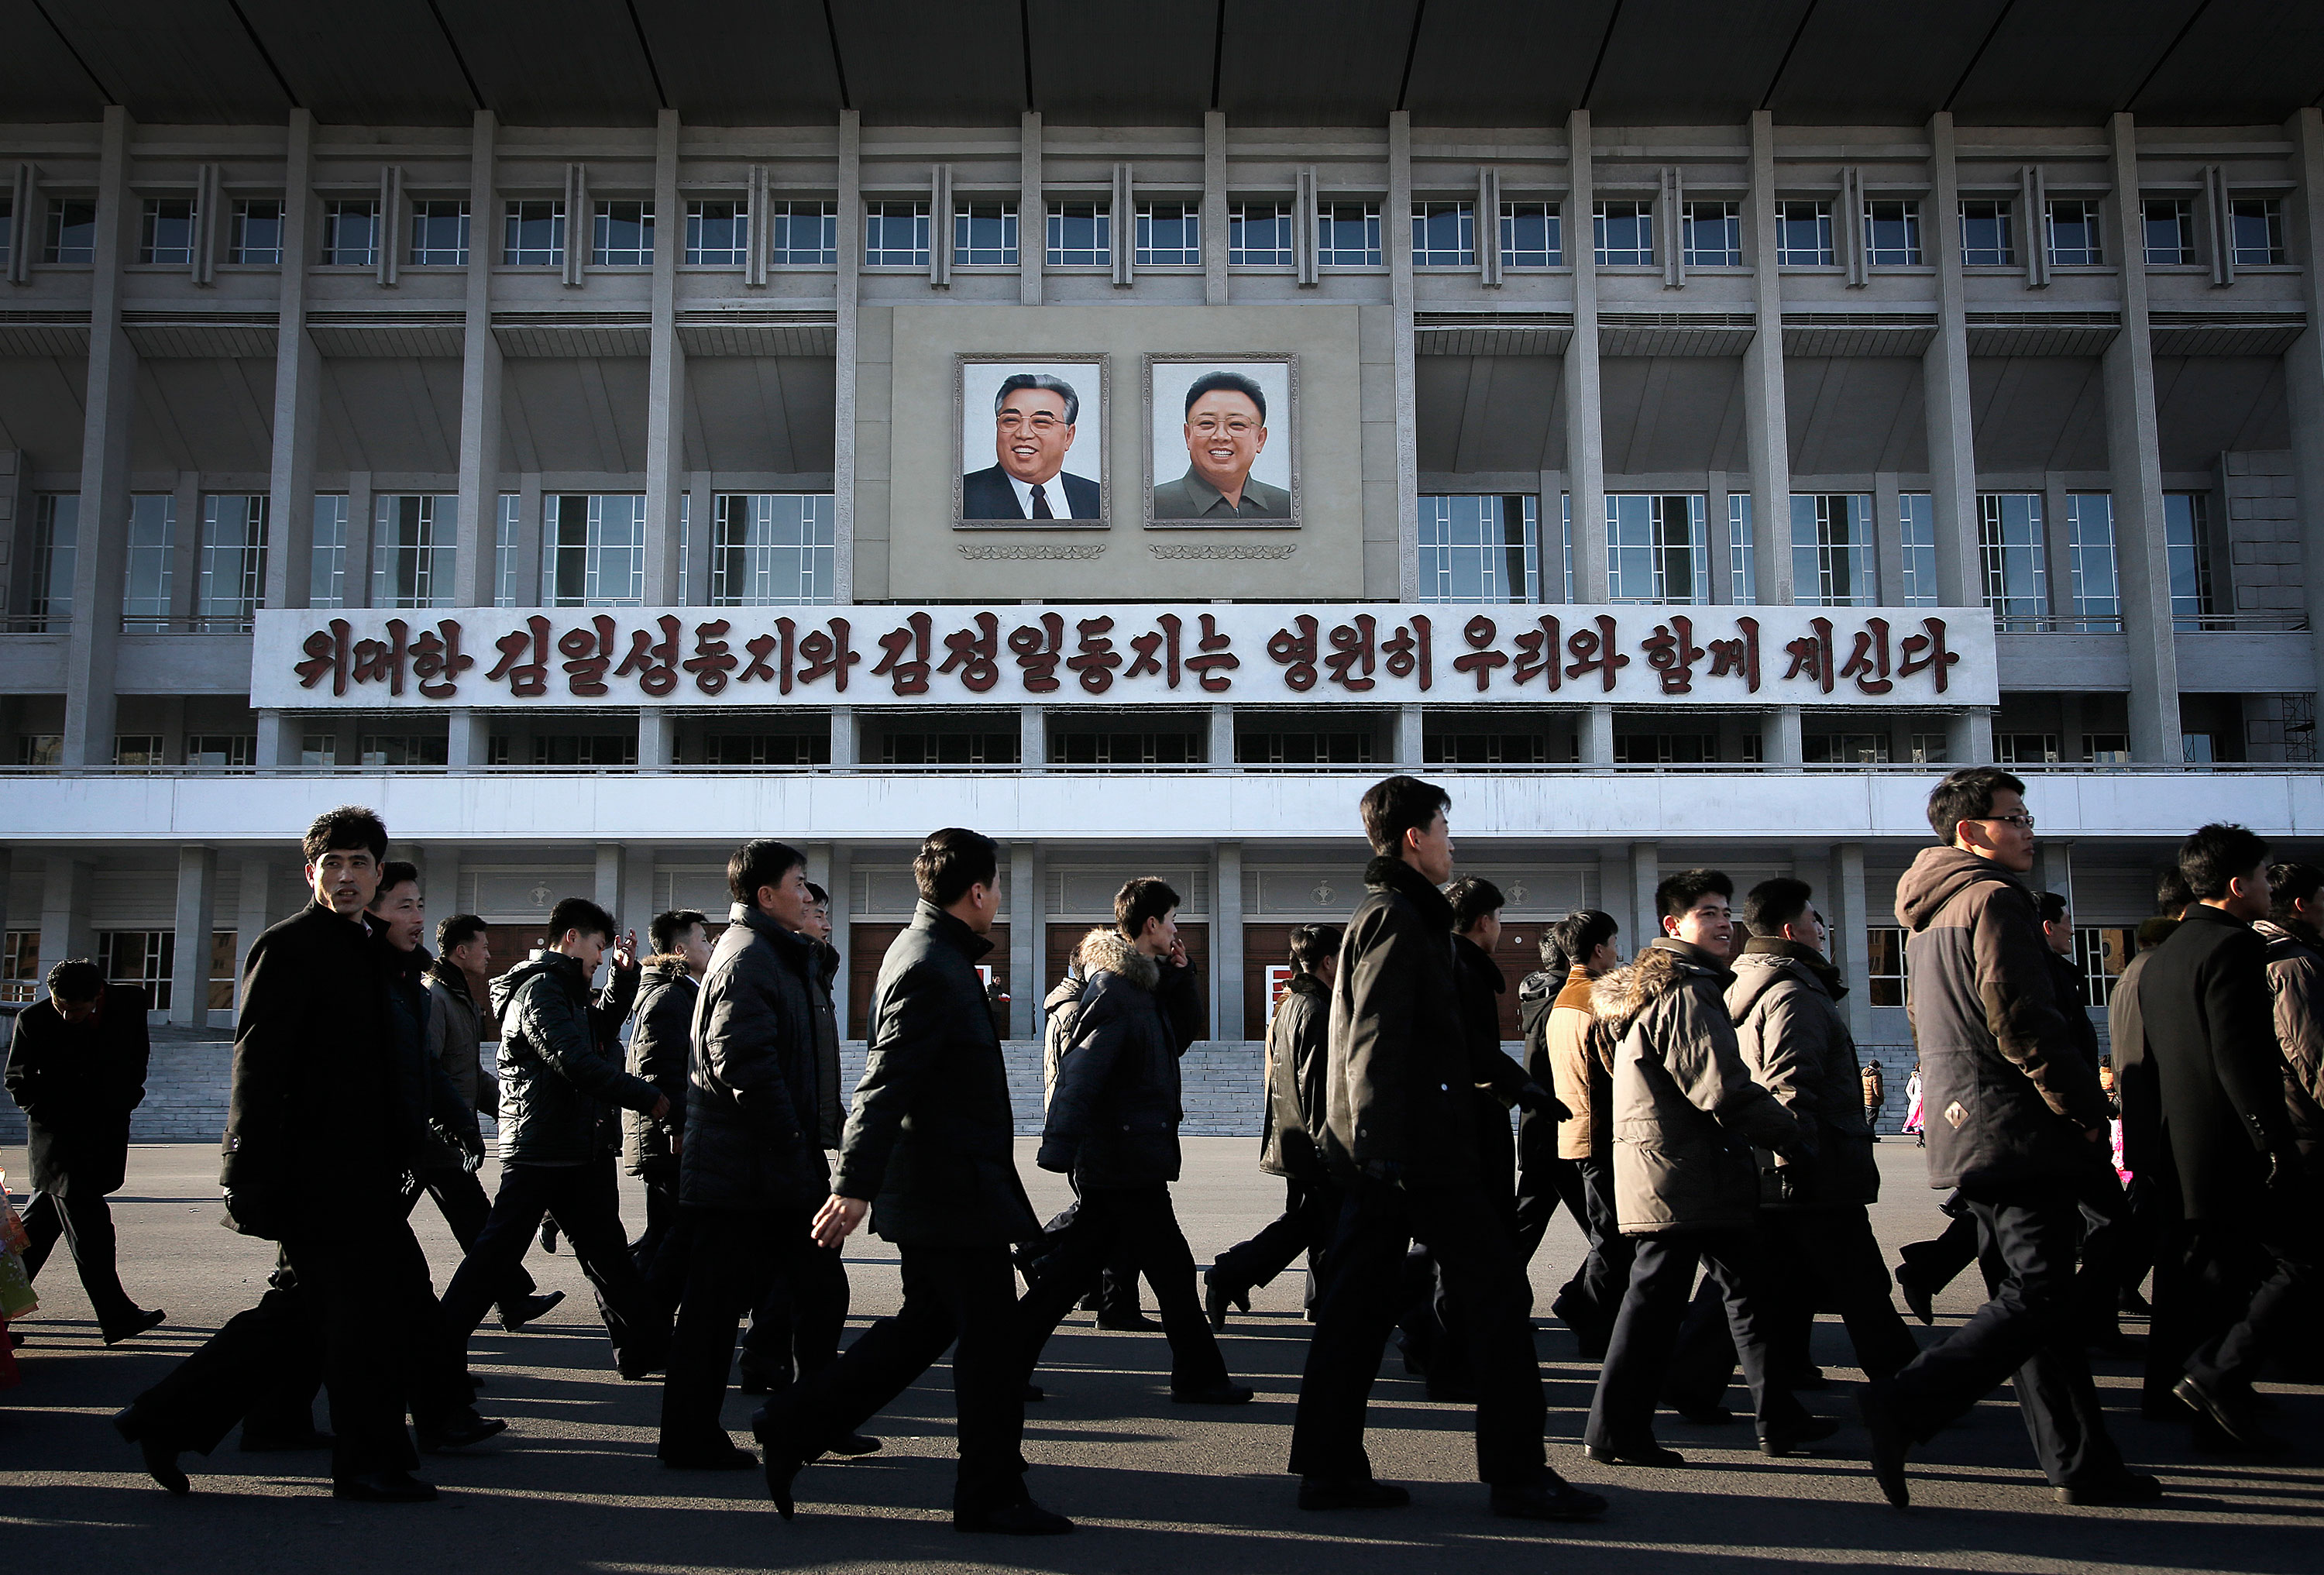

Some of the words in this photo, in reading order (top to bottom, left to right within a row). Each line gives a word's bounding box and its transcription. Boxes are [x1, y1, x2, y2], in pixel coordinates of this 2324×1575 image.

[294, 618, 474, 699] 위대한
[484, 614, 861, 697] 김일성동지와
[870, 612, 1240, 696] 김정일동지는
[1267, 614, 1434, 693] 영원히
[1452, 614, 1630, 693] 우리와
[1642, 614, 1762, 696] 함께
[1783, 616, 1960, 696] 계신다
